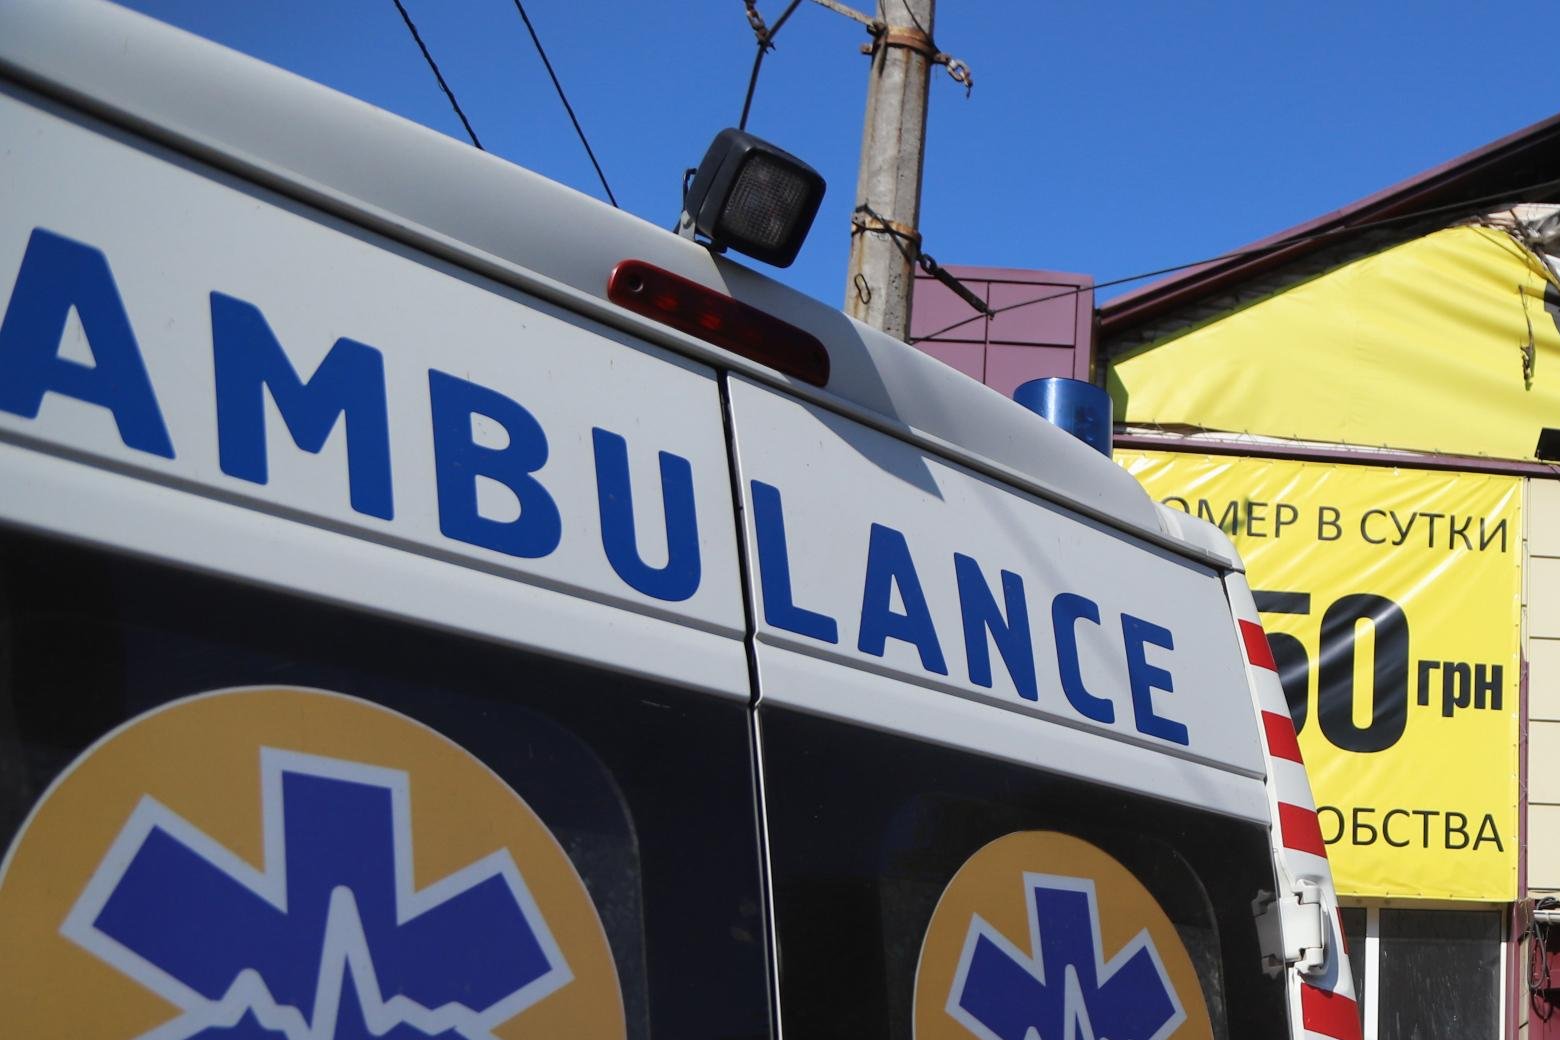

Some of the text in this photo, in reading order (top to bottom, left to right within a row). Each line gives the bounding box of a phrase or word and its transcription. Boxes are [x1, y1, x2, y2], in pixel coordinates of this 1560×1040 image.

[0, 226, 1190, 748] AMBULANCE
[1317, 506, 1343, 542] В
[1359, 508, 1508, 553] СУТКИ
[1417, 660, 1503, 718] грн
